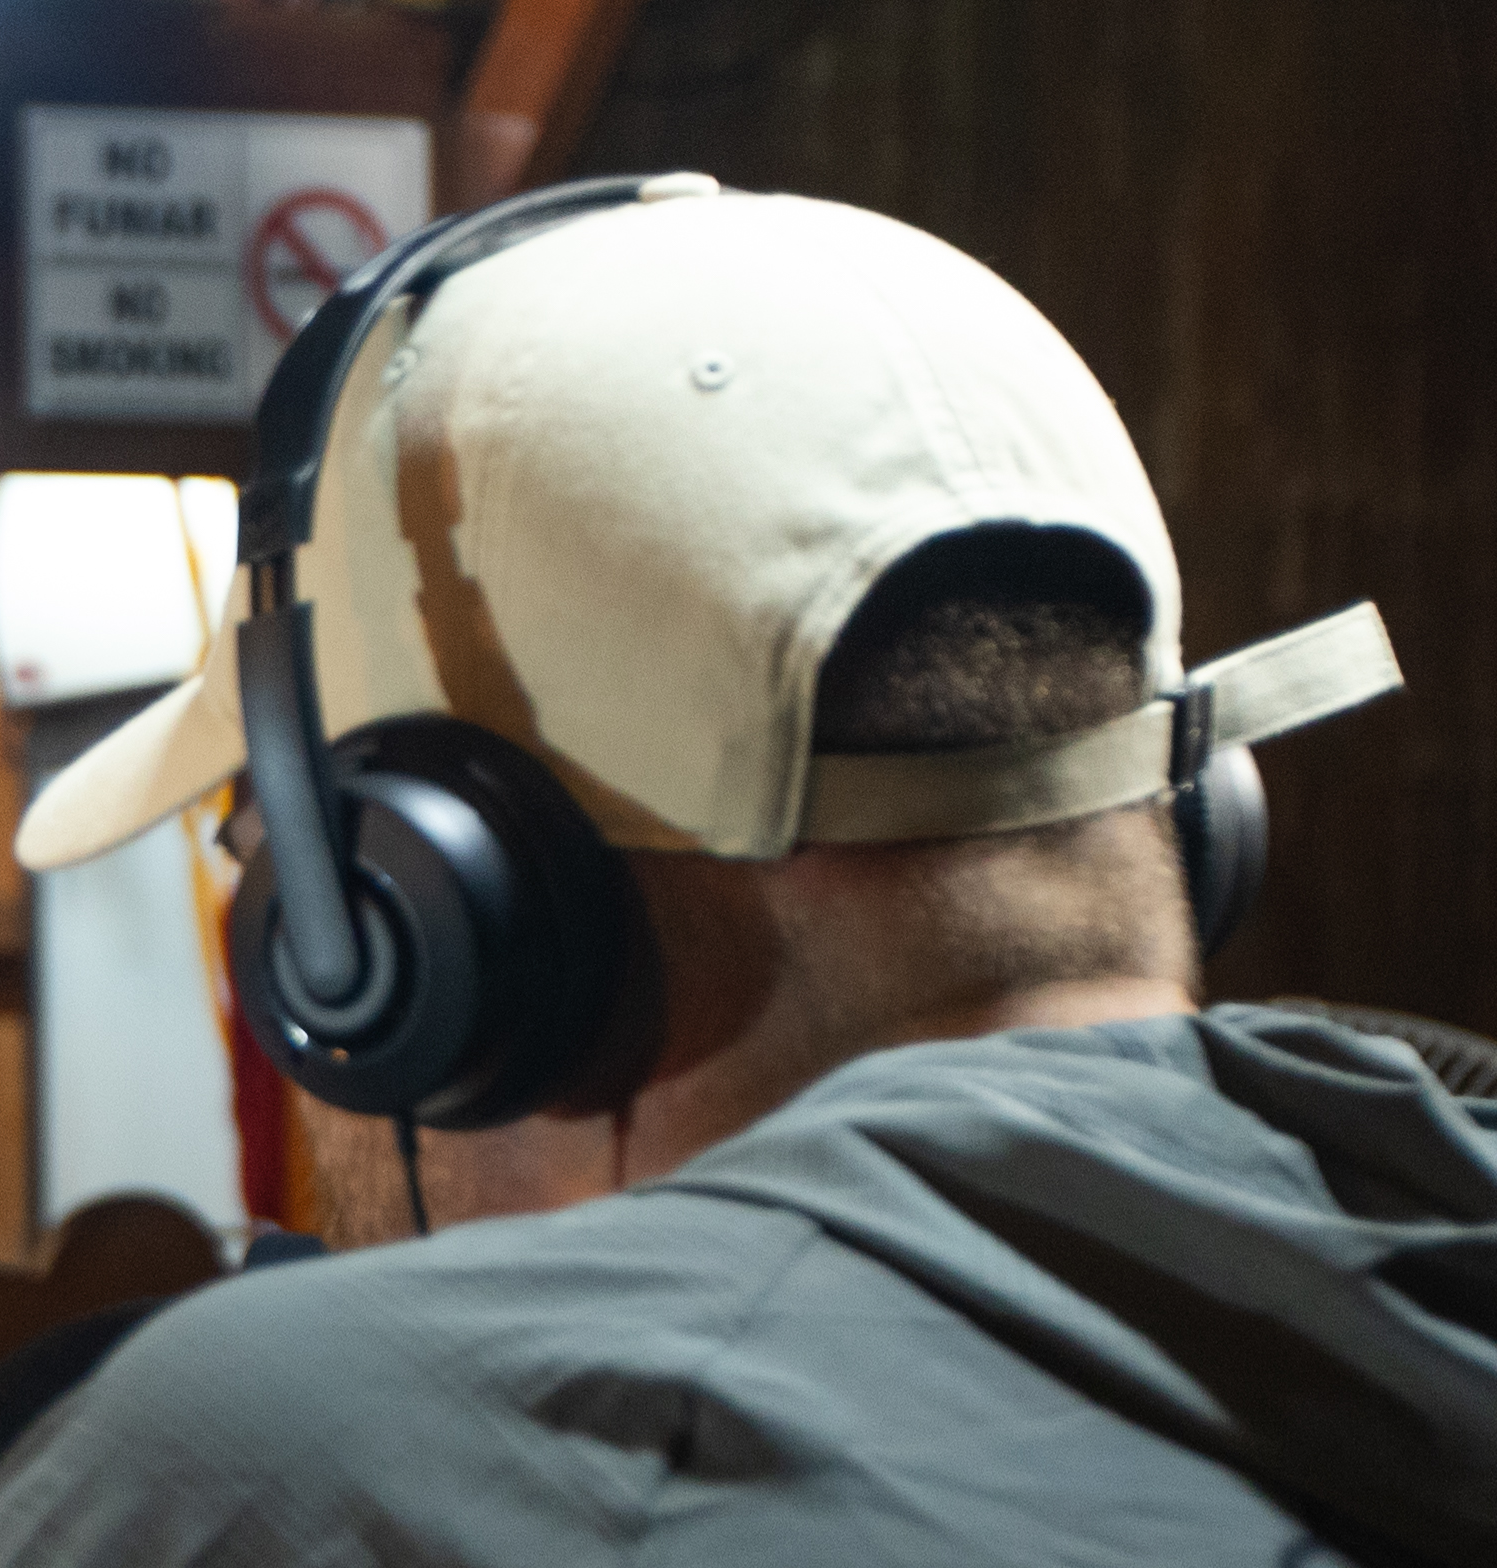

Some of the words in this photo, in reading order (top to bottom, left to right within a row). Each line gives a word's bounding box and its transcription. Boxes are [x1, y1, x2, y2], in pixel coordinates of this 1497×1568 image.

[103, 139, 172, 180] NO
[53, 197, 217, 239] FUMAR
[112, 285, 168, 325] NO
[50, 339, 232, 379] SMOKING
